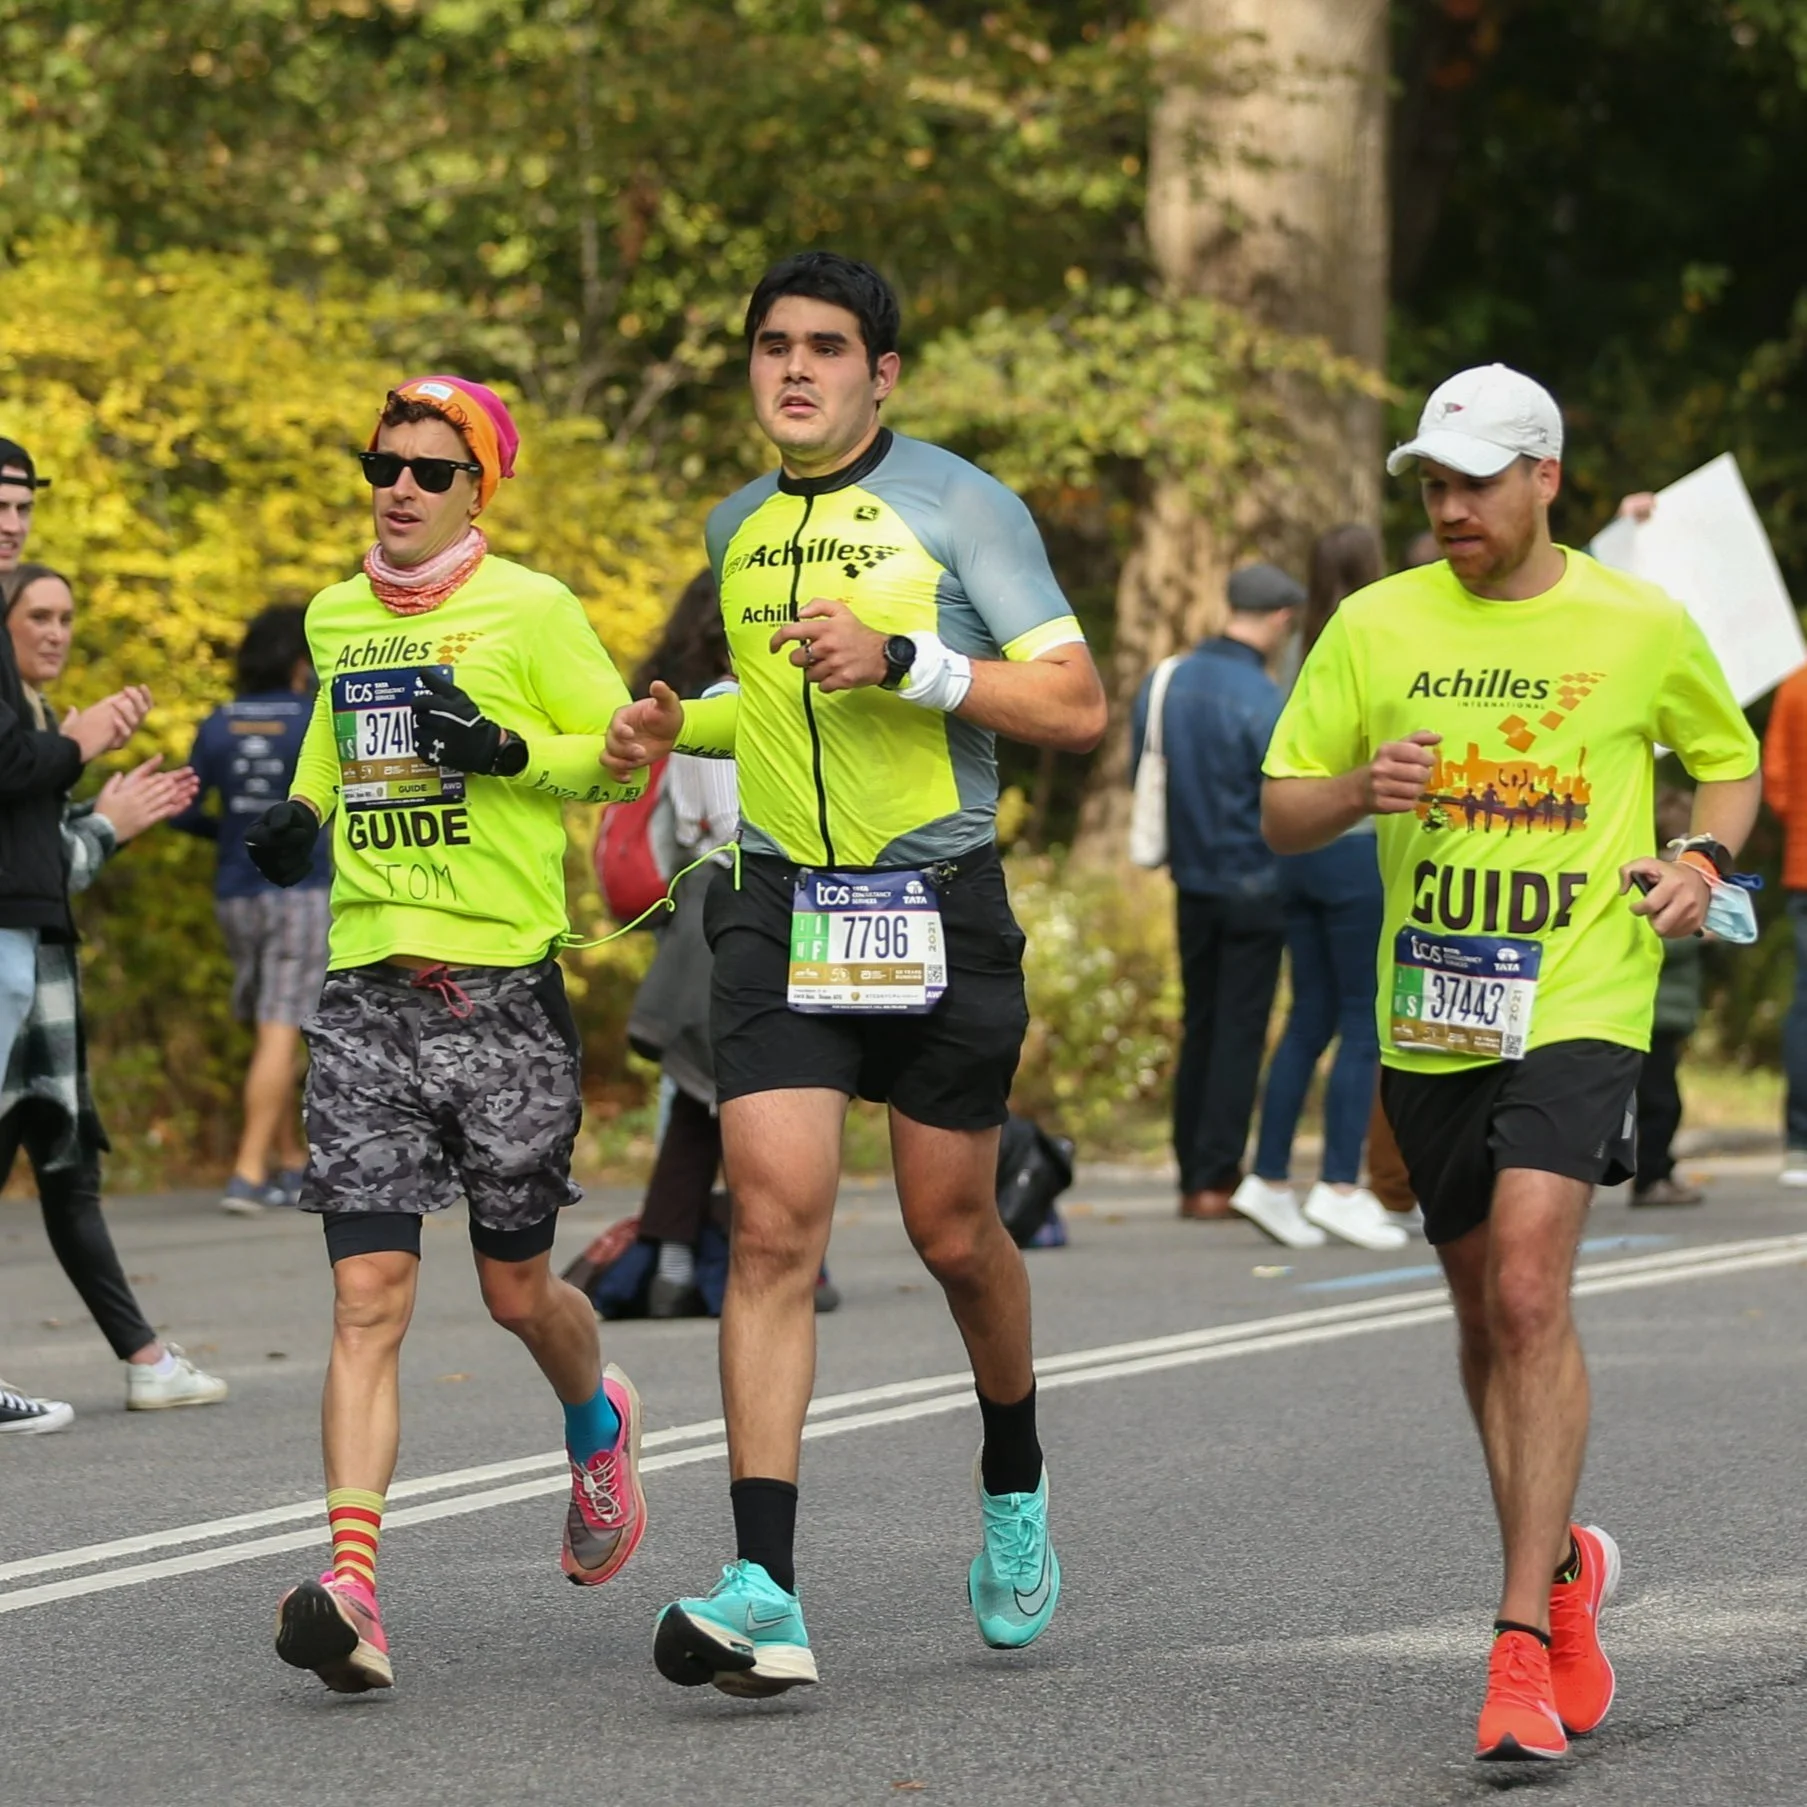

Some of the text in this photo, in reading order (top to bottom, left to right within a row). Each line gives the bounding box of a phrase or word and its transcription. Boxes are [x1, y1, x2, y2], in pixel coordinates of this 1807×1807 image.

[747, 537, 871, 569] Achilles
[741, 602, 800, 625] Achill
[335, 635, 432, 671] Achilles
[345, 680, 373, 704] tcs
[1407, 668, 1549, 700] Achilles
[1457, 700, 1546, 710] INTERNATIONAL
[366, 711, 417, 756] 3741
[398, 784, 428, 794] GUIDE
[442, 782, 463, 790] AWD
[348, 808, 471, 850] GUIDE
[374, 863, 457, 901] TOM
[816, 882, 850, 905] tcs
[1411, 860, 1588, 934] GUIDE
[902, 896, 927, 904] TATA
[843, 915, 909, 959] 7796
[928, 921, 937, 952] 2021
[1411, 935, 1442, 963] tcs
[1493, 963, 1520, 972] TATA
[1406, 995, 1418, 1018] S
[1431, 974, 1505, 1025] 37443
[1510, 989, 1523, 1021] 2021
